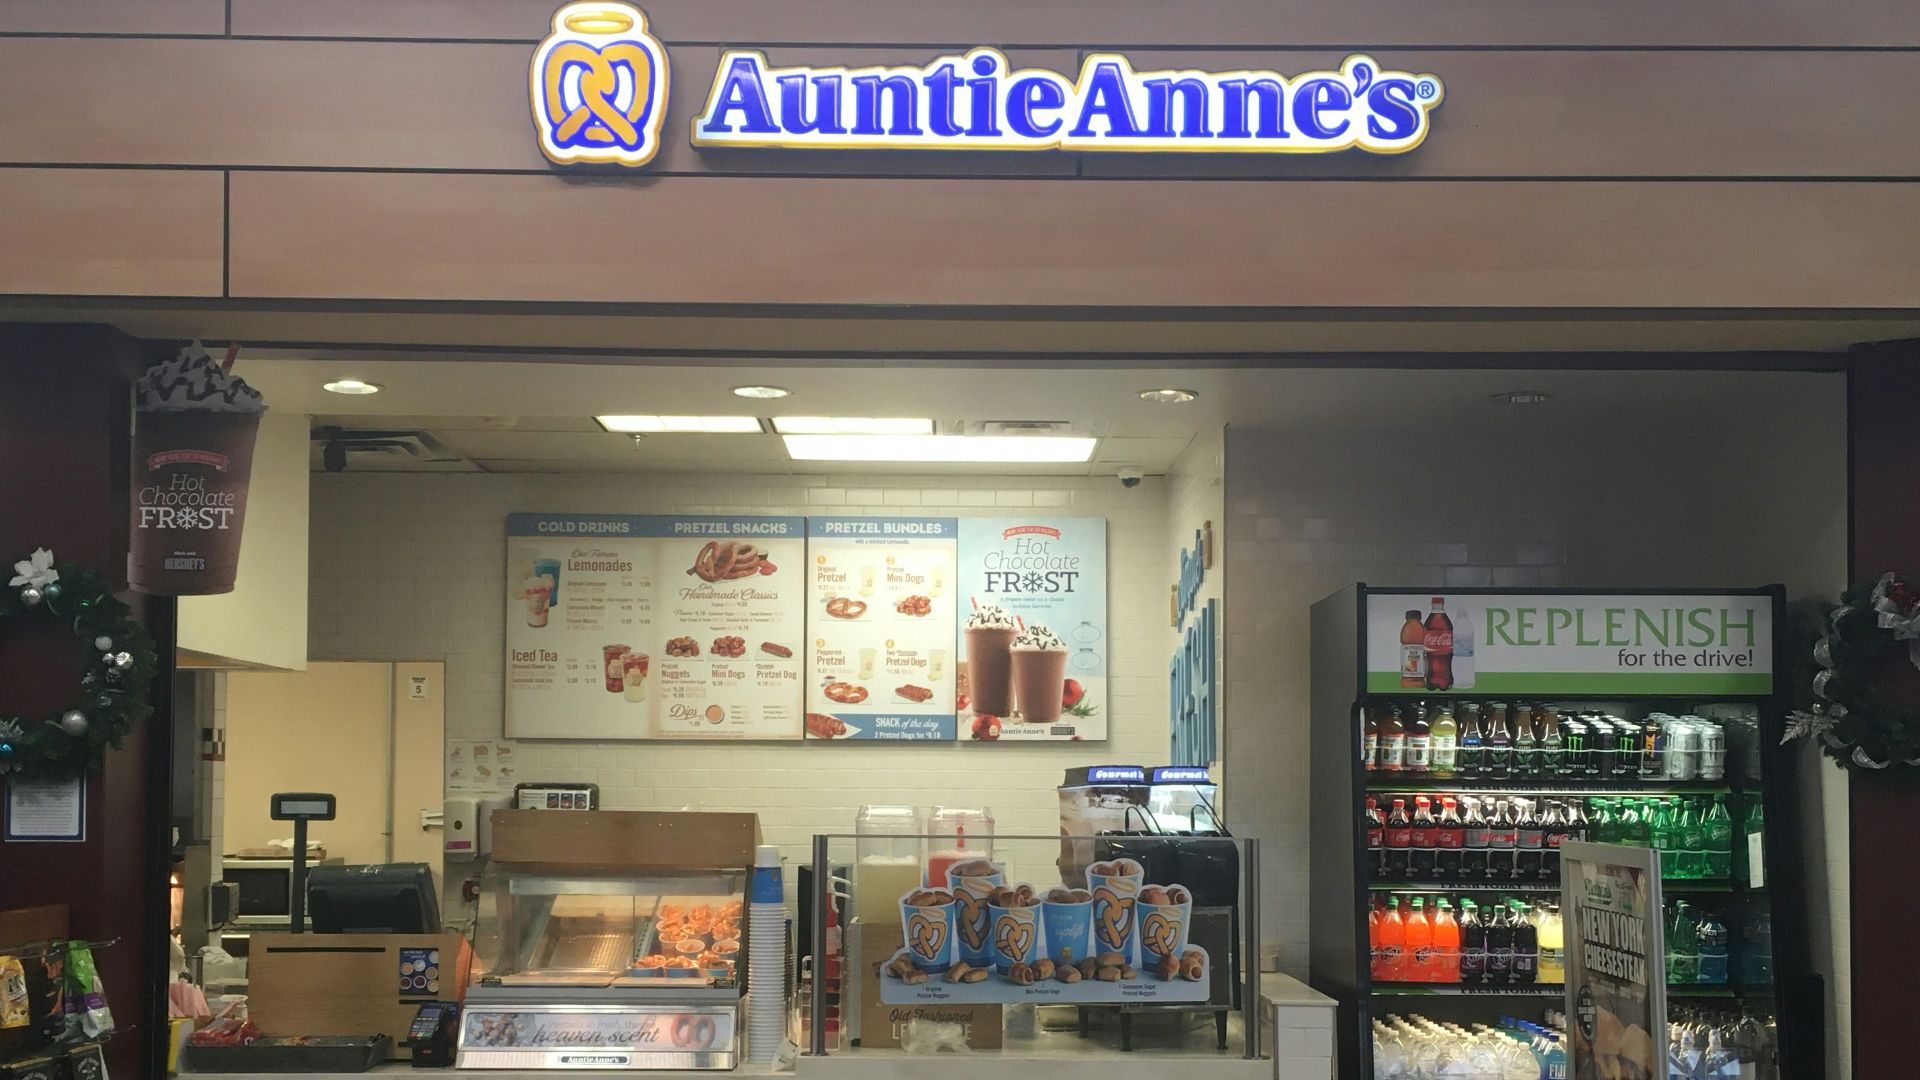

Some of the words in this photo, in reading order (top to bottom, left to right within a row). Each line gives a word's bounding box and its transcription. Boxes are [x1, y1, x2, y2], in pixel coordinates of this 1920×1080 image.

[169, 473, 206, 491] Hot
[139, 485, 236, 506] Chocolate
[538, 521, 576, 533] COLD
[578, 521, 630, 533] DRINKS
[674, 522, 731, 534] PRETZEL
[732, 522, 788, 534] SNACKS
[825, 522, 881, 534] PRETZEL
[883, 522, 942, 534] BUNDLES
[1013, 537, 1051, 555] Hot
[567, 559, 633, 572] Lemonades
[984, 550, 1080, 569] Chocolate
[817, 573, 847, 582] Pretzel
[886, 573, 903, 582] Mini
[905, 573, 925, 585] Dogs
[679, 586, 740, 601] Handmade
[740, 587, 778, 601] Classics
[1484, 607, 1756, 647] REPLENISH
[512, 649, 536, 662] Iced
[538, 649, 558, 662] Tea
[816, 656, 846, 666] Pretzel
[1617, 649, 1645, 667] for
[1653, 649, 1687, 667] the
[1694, 648, 1753, 667] drive!
[886, 657, 909, 666] Pretzel
[910, 657, 928, 668] Dogs
[661, 670, 691, 679] Nuggets
[711, 670, 727, 678] Mini
[728, 670, 746, 680] Dogs
[756, 670, 782, 678] Pretzel
[783, 670, 797, 680] Dog
[415, 685, 422, 694] 5
[669, 703, 698, 720] Dips
[875, 718, 901, 727] SNACK
[901, 719, 911, 729] of
[910, 718, 922, 727] the
[923, 719, 939, 731] day
[1095, 770, 1137, 779] Gourmet
[1161, 770, 1203, 779] Gourmet
[1582, 906, 1611, 946] NEW
[1611, 911, 1646, 955] YORK
[1583, 942, 1647, 986] CHEESESTEAK
[889, 1008, 912, 1022] Old
[912, 1008, 974, 1022] Fashioned
[531, 1023, 603, 1044] heaven
[607, 1027, 661, 1043] scent
[1549, 1063, 1567, 1078] FIJI
